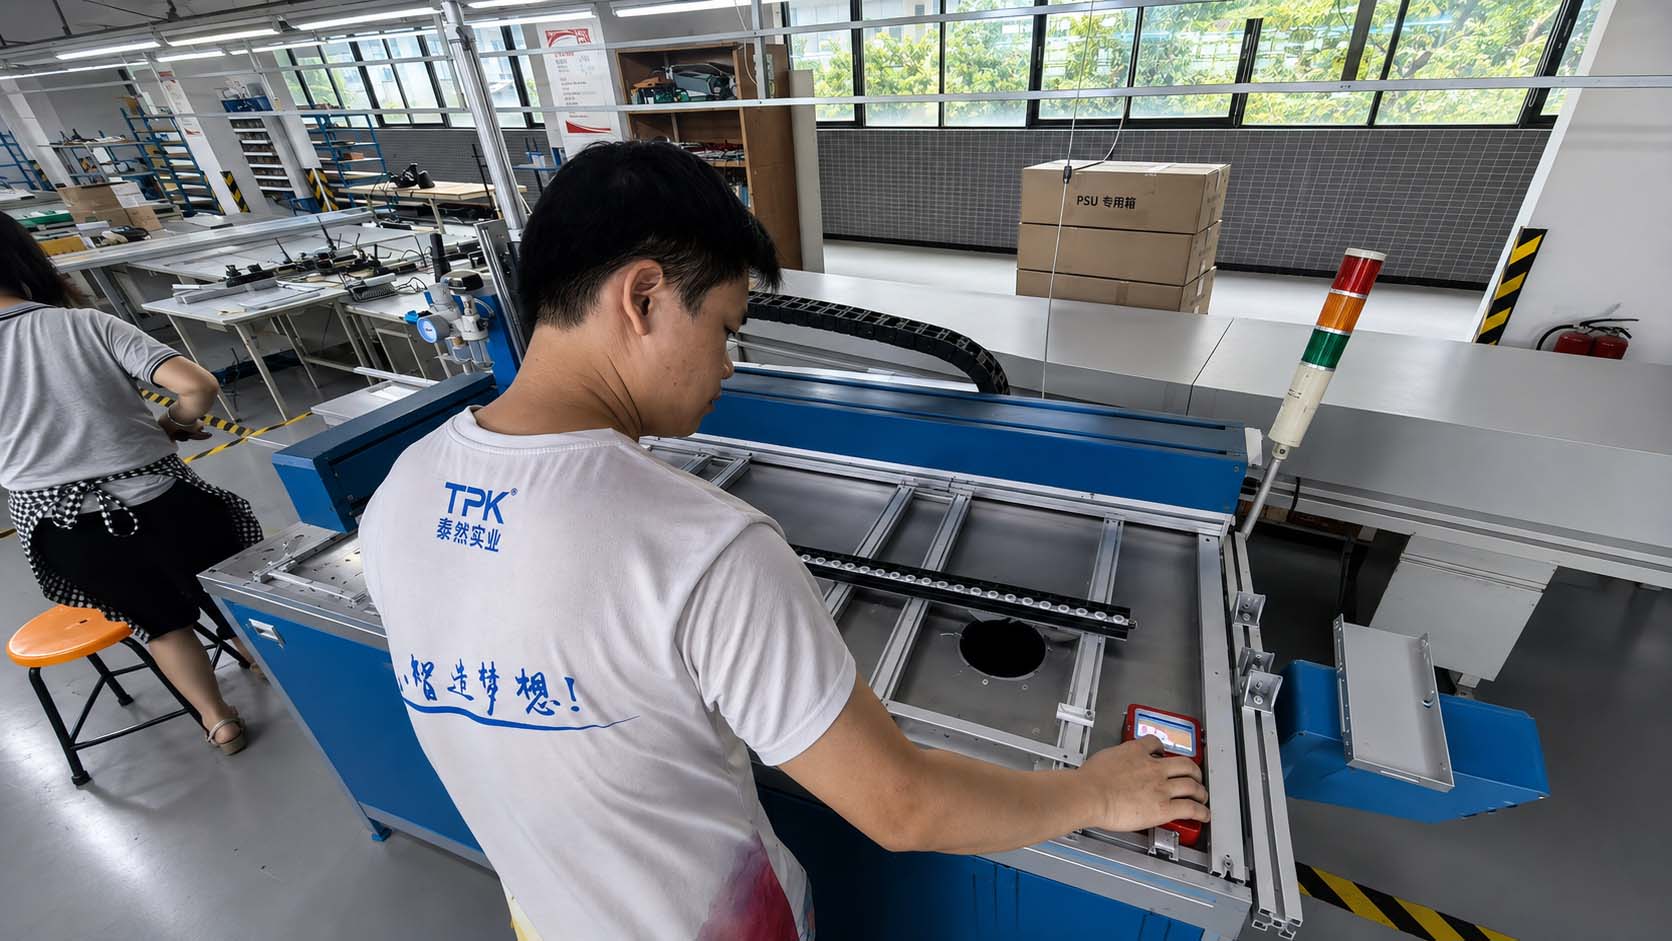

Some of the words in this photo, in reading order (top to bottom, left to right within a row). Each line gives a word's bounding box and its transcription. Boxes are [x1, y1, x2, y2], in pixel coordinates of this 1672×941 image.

[1076, 195, 1098, 206] PSU
[1102, 195, 1136, 209] 专用箱
[436, 517, 501, 552] 泰然实业
